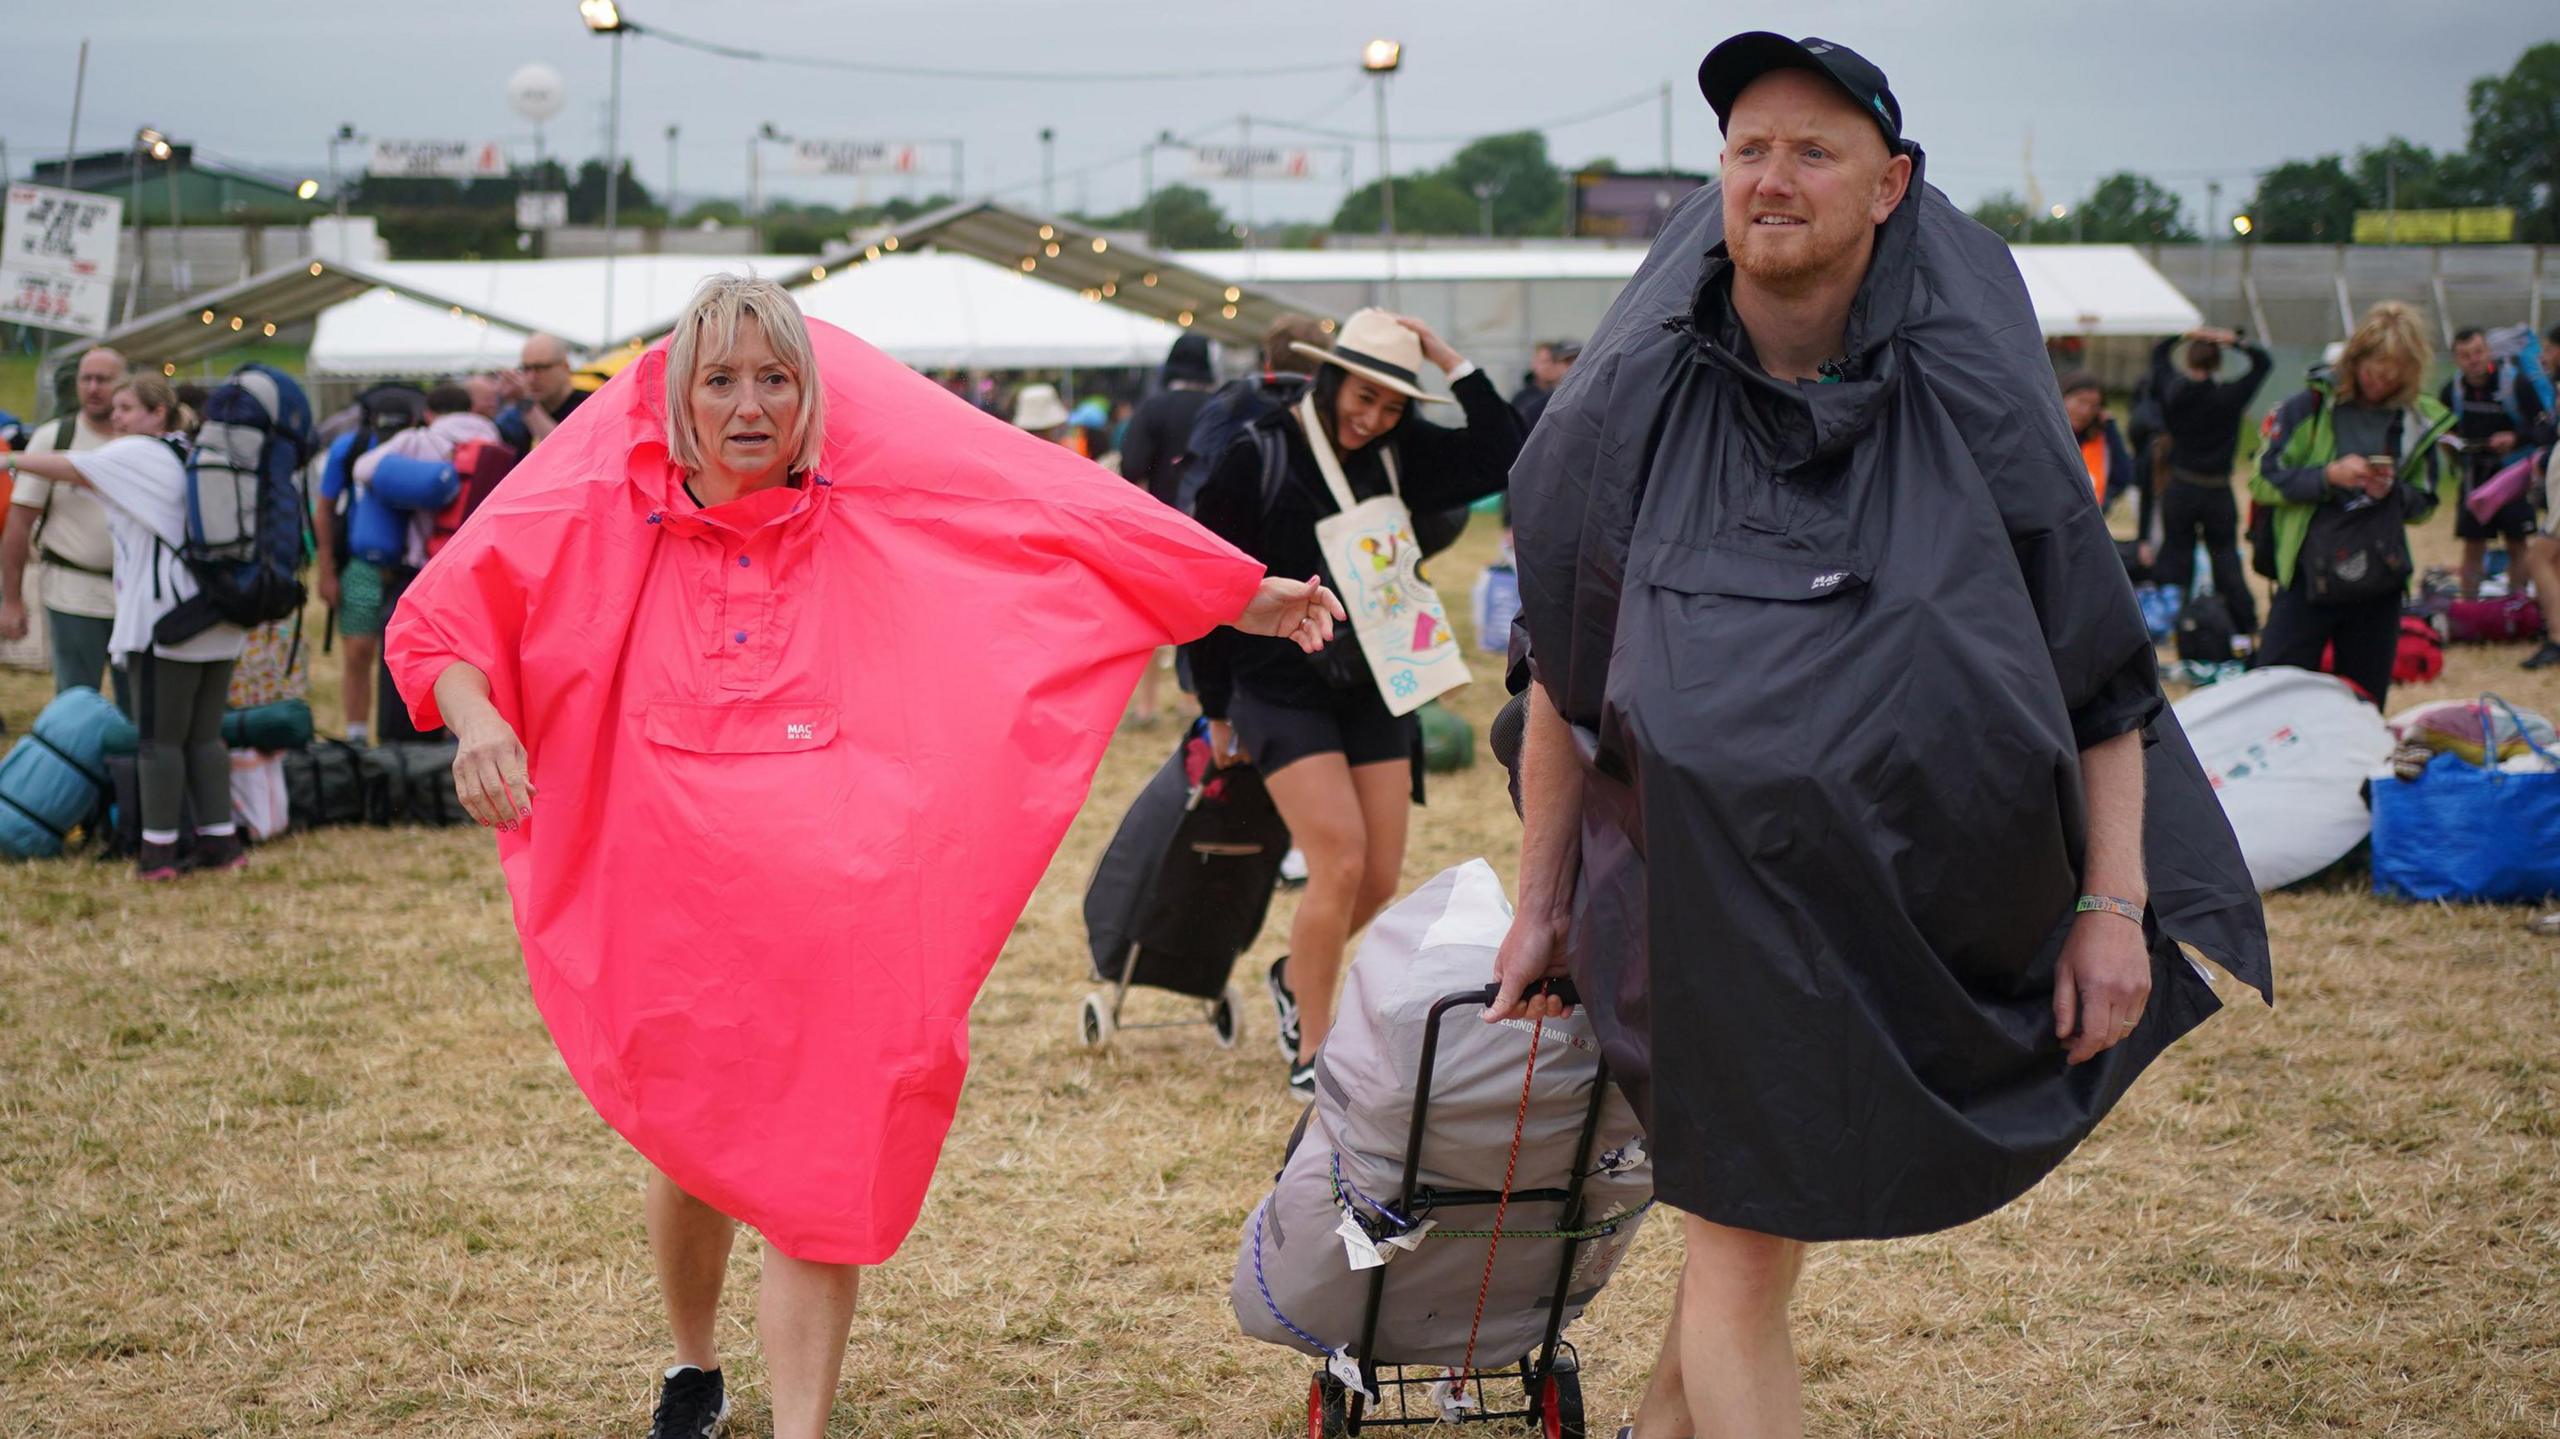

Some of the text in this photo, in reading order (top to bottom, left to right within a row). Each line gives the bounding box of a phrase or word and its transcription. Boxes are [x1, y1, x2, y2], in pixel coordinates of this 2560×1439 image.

[1813, 572, 1842, 585] MAC
[787, 723, 812, 734] MAC
[1540, 1026, 1572, 1044] FAMILY
